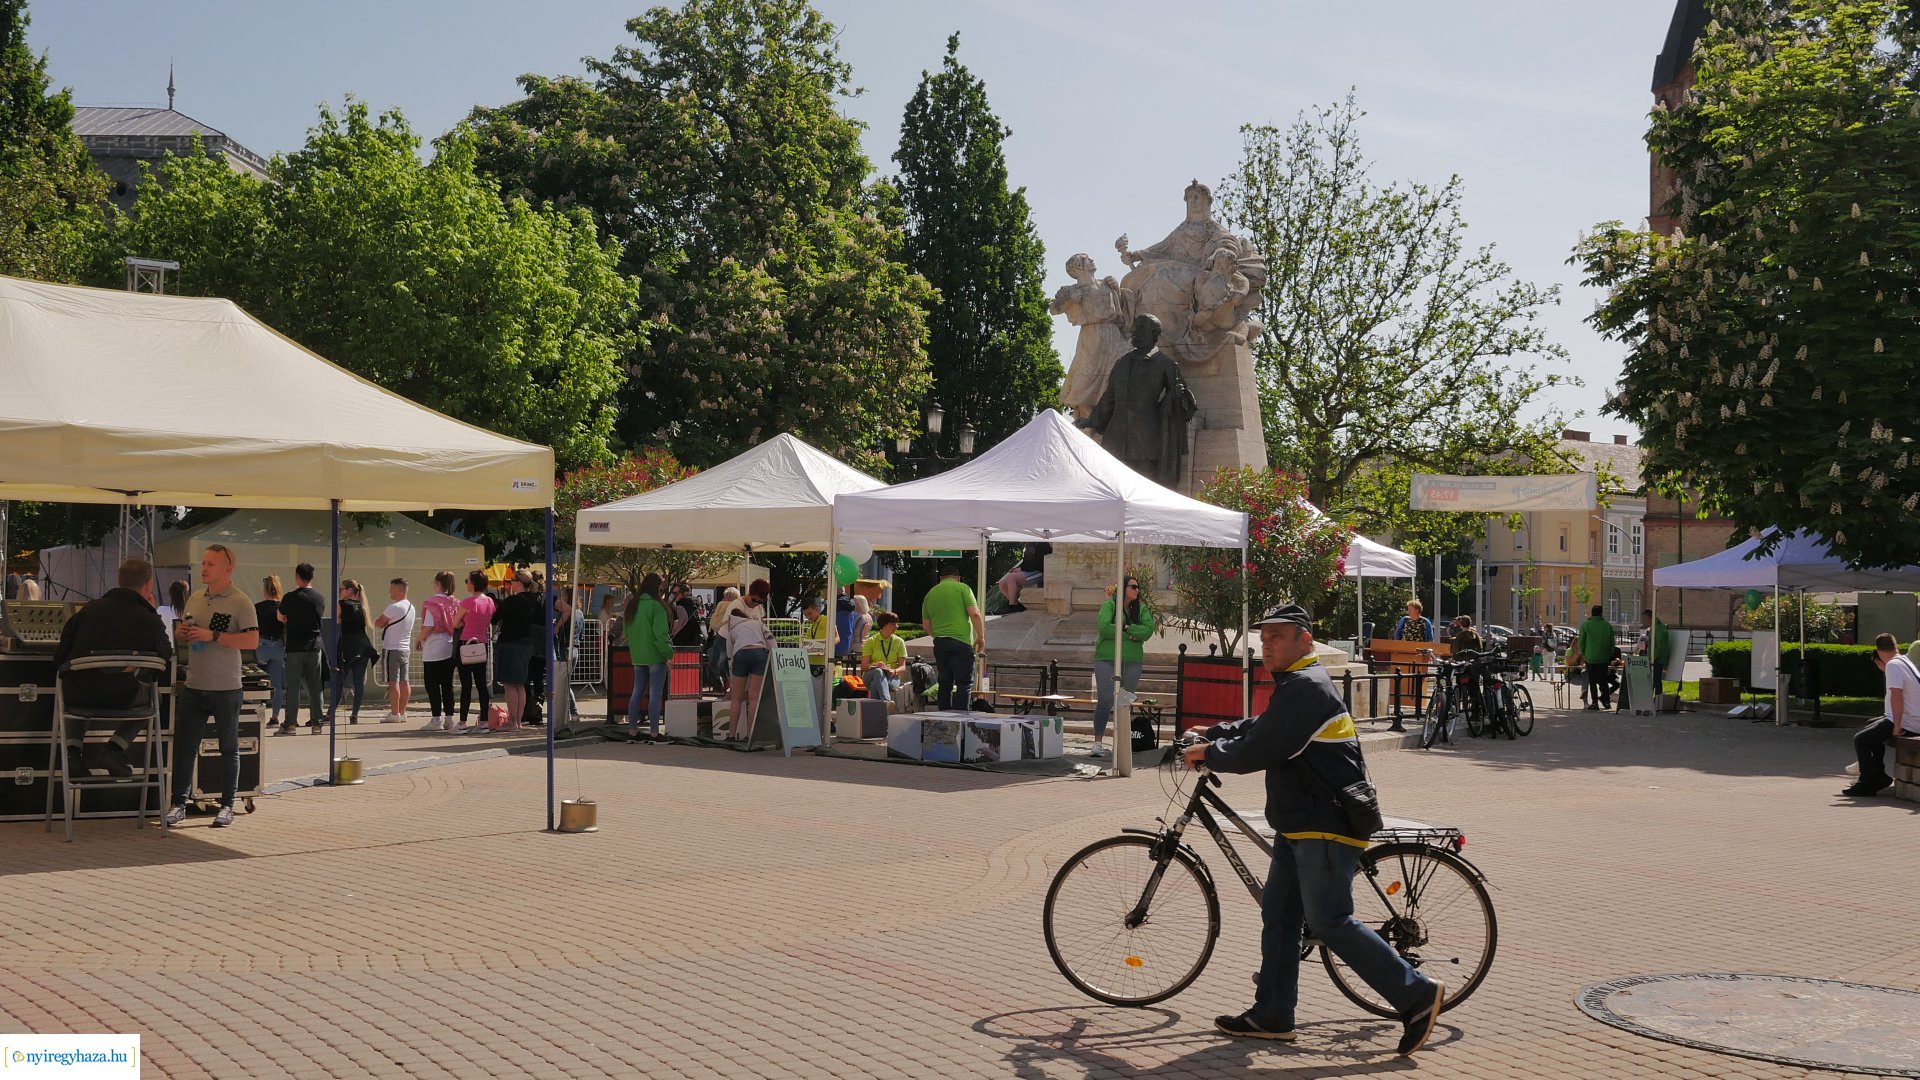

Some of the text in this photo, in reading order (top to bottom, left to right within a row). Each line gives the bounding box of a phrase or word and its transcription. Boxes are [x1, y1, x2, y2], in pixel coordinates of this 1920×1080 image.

[775, 651, 806, 671] Kirakó
[1627, 657, 1648, 668] Puzzle
[1217, 837, 1255, 886] YAZOO
